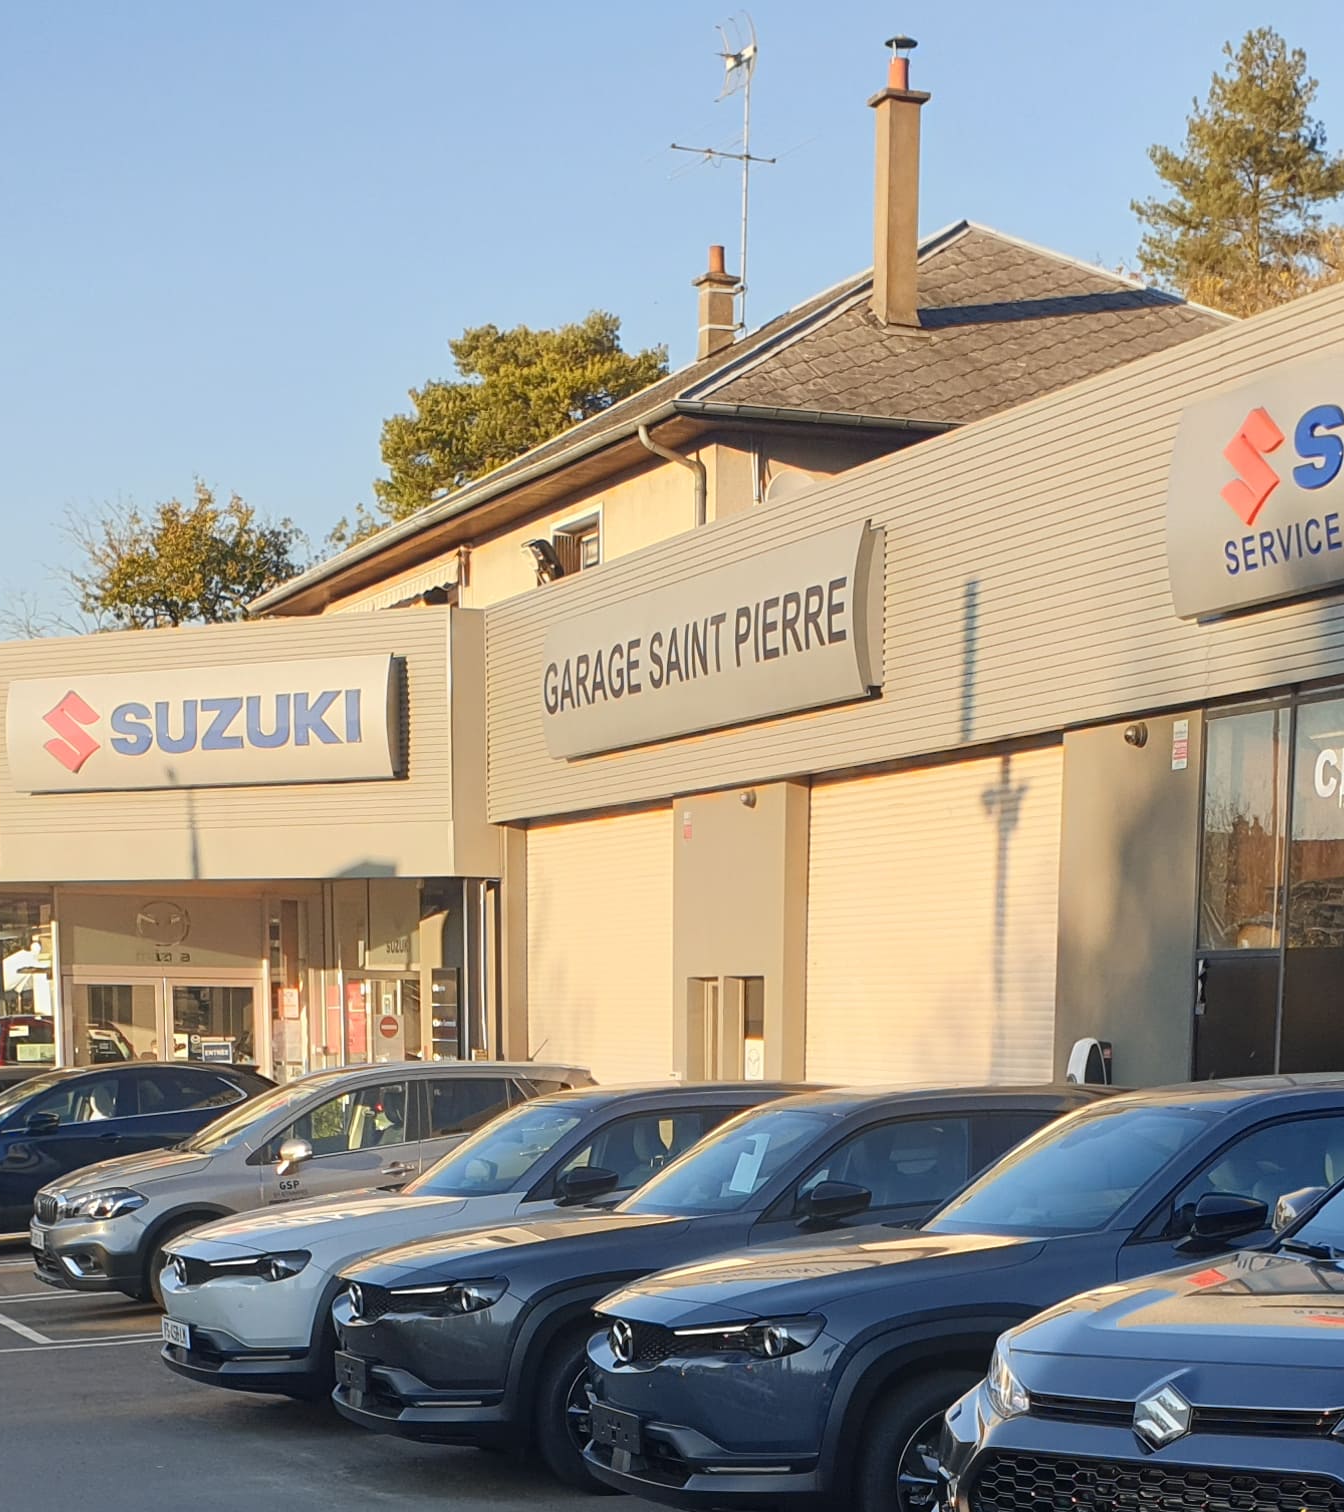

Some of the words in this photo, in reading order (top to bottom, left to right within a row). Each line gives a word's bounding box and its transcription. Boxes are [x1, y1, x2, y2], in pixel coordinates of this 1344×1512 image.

[1224, 511, 1343, 575] SERVICE
[544, 636, 643, 716] GARAGE
[648, 612, 726, 690] SAINT
[734, 576, 849, 665] PIERRE
[111, 688, 363, 756] SUZUKI
[279, 1180, 300, 1190] GSP
